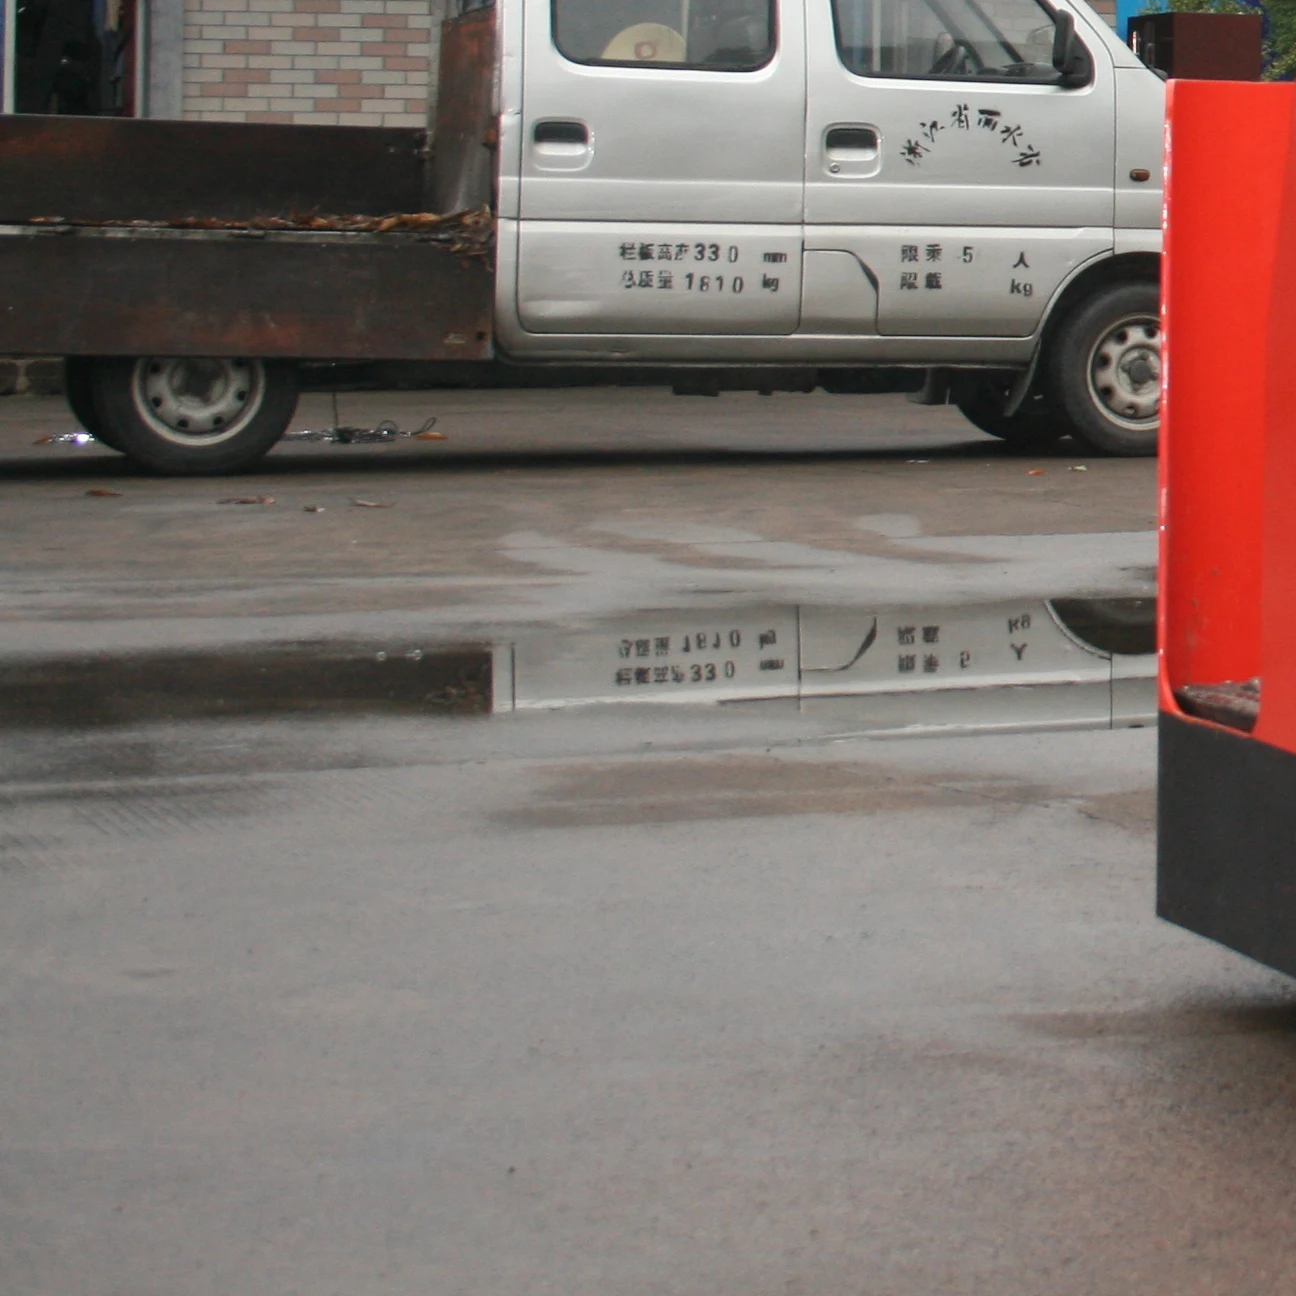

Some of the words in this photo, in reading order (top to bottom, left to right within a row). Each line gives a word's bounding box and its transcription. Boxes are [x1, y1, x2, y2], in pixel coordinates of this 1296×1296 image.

[961, 246, 974, 264] 5
[1012, 251, 1030, 270] 人
[685, 272, 744, 294] 1810
[1010, 278, 1033, 296] kg
